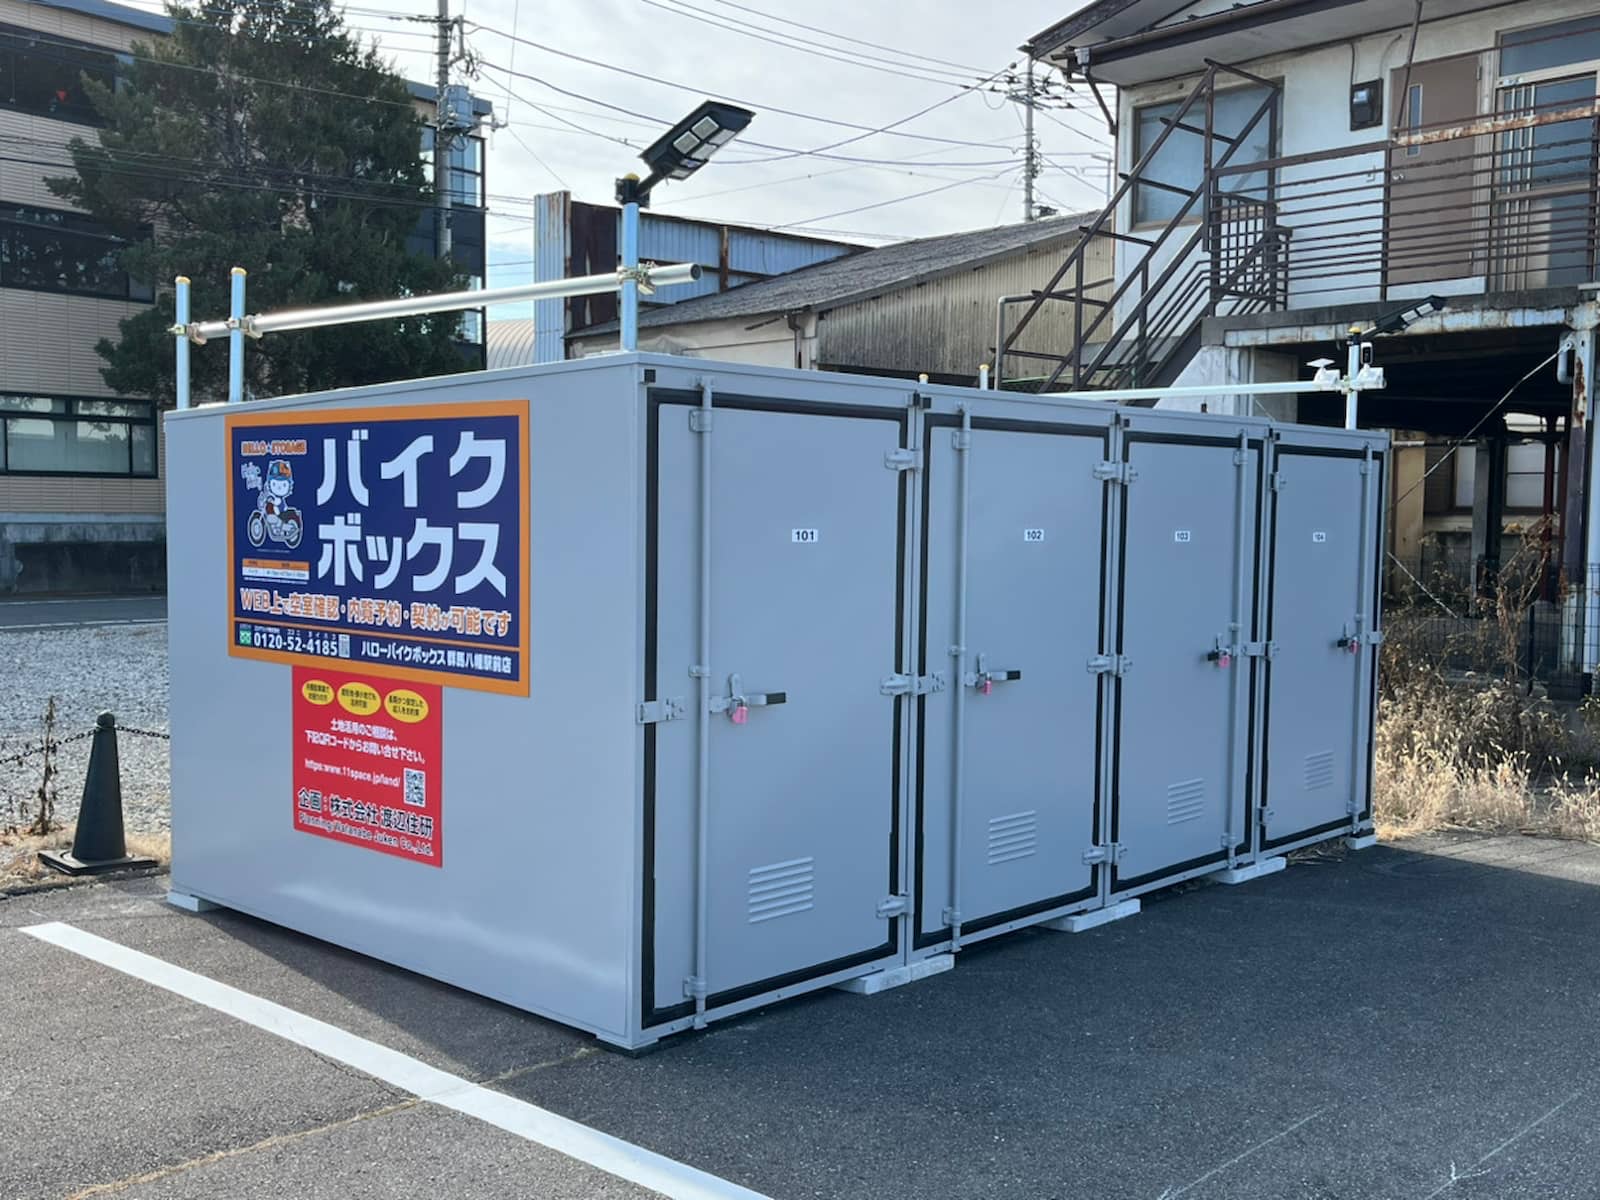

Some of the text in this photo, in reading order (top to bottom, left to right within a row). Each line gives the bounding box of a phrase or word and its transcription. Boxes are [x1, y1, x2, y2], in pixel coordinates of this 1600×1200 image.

[317, 429, 506, 509] バイク
[796, 530, 814, 541] 101
[1027, 530, 1042, 540] 102
[318, 513, 506, 598] ボックス
[253, 632, 338, 656] 0120-52-4185
[379, 805, 433, 840] 渡辺住研
